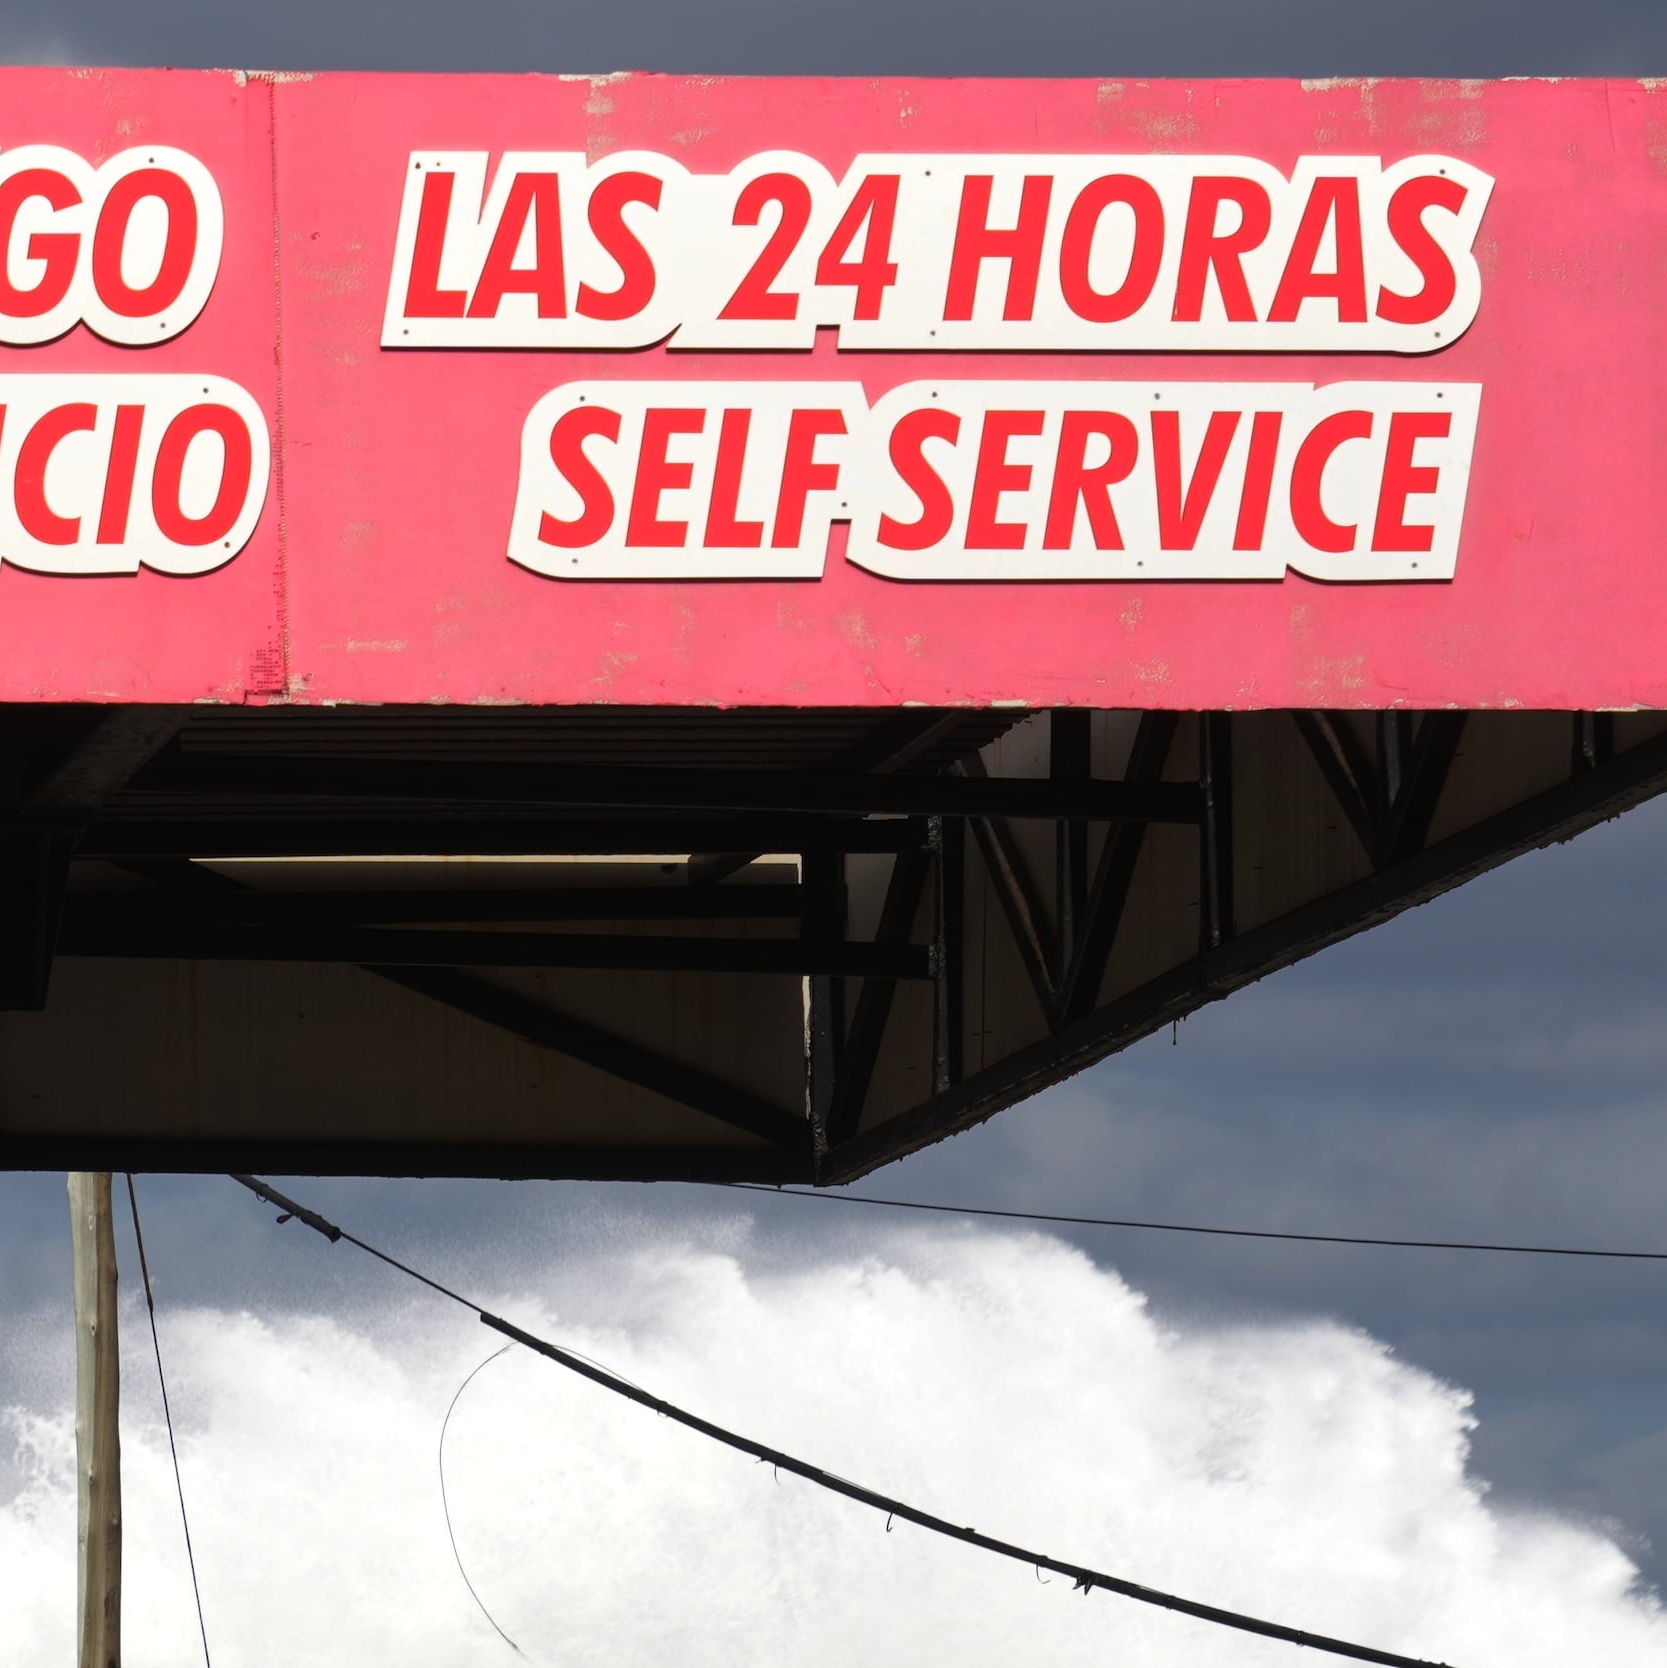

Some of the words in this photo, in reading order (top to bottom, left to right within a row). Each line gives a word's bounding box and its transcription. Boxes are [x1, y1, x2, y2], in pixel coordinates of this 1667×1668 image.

[402, 170, 664, 322] LAS
[719, 172, 901, 321] 24
[942, 173, 1470, 325] HORAS
[537, 405, 849, 549] SELF
[876, 409, 1453, 554] SERVICE
